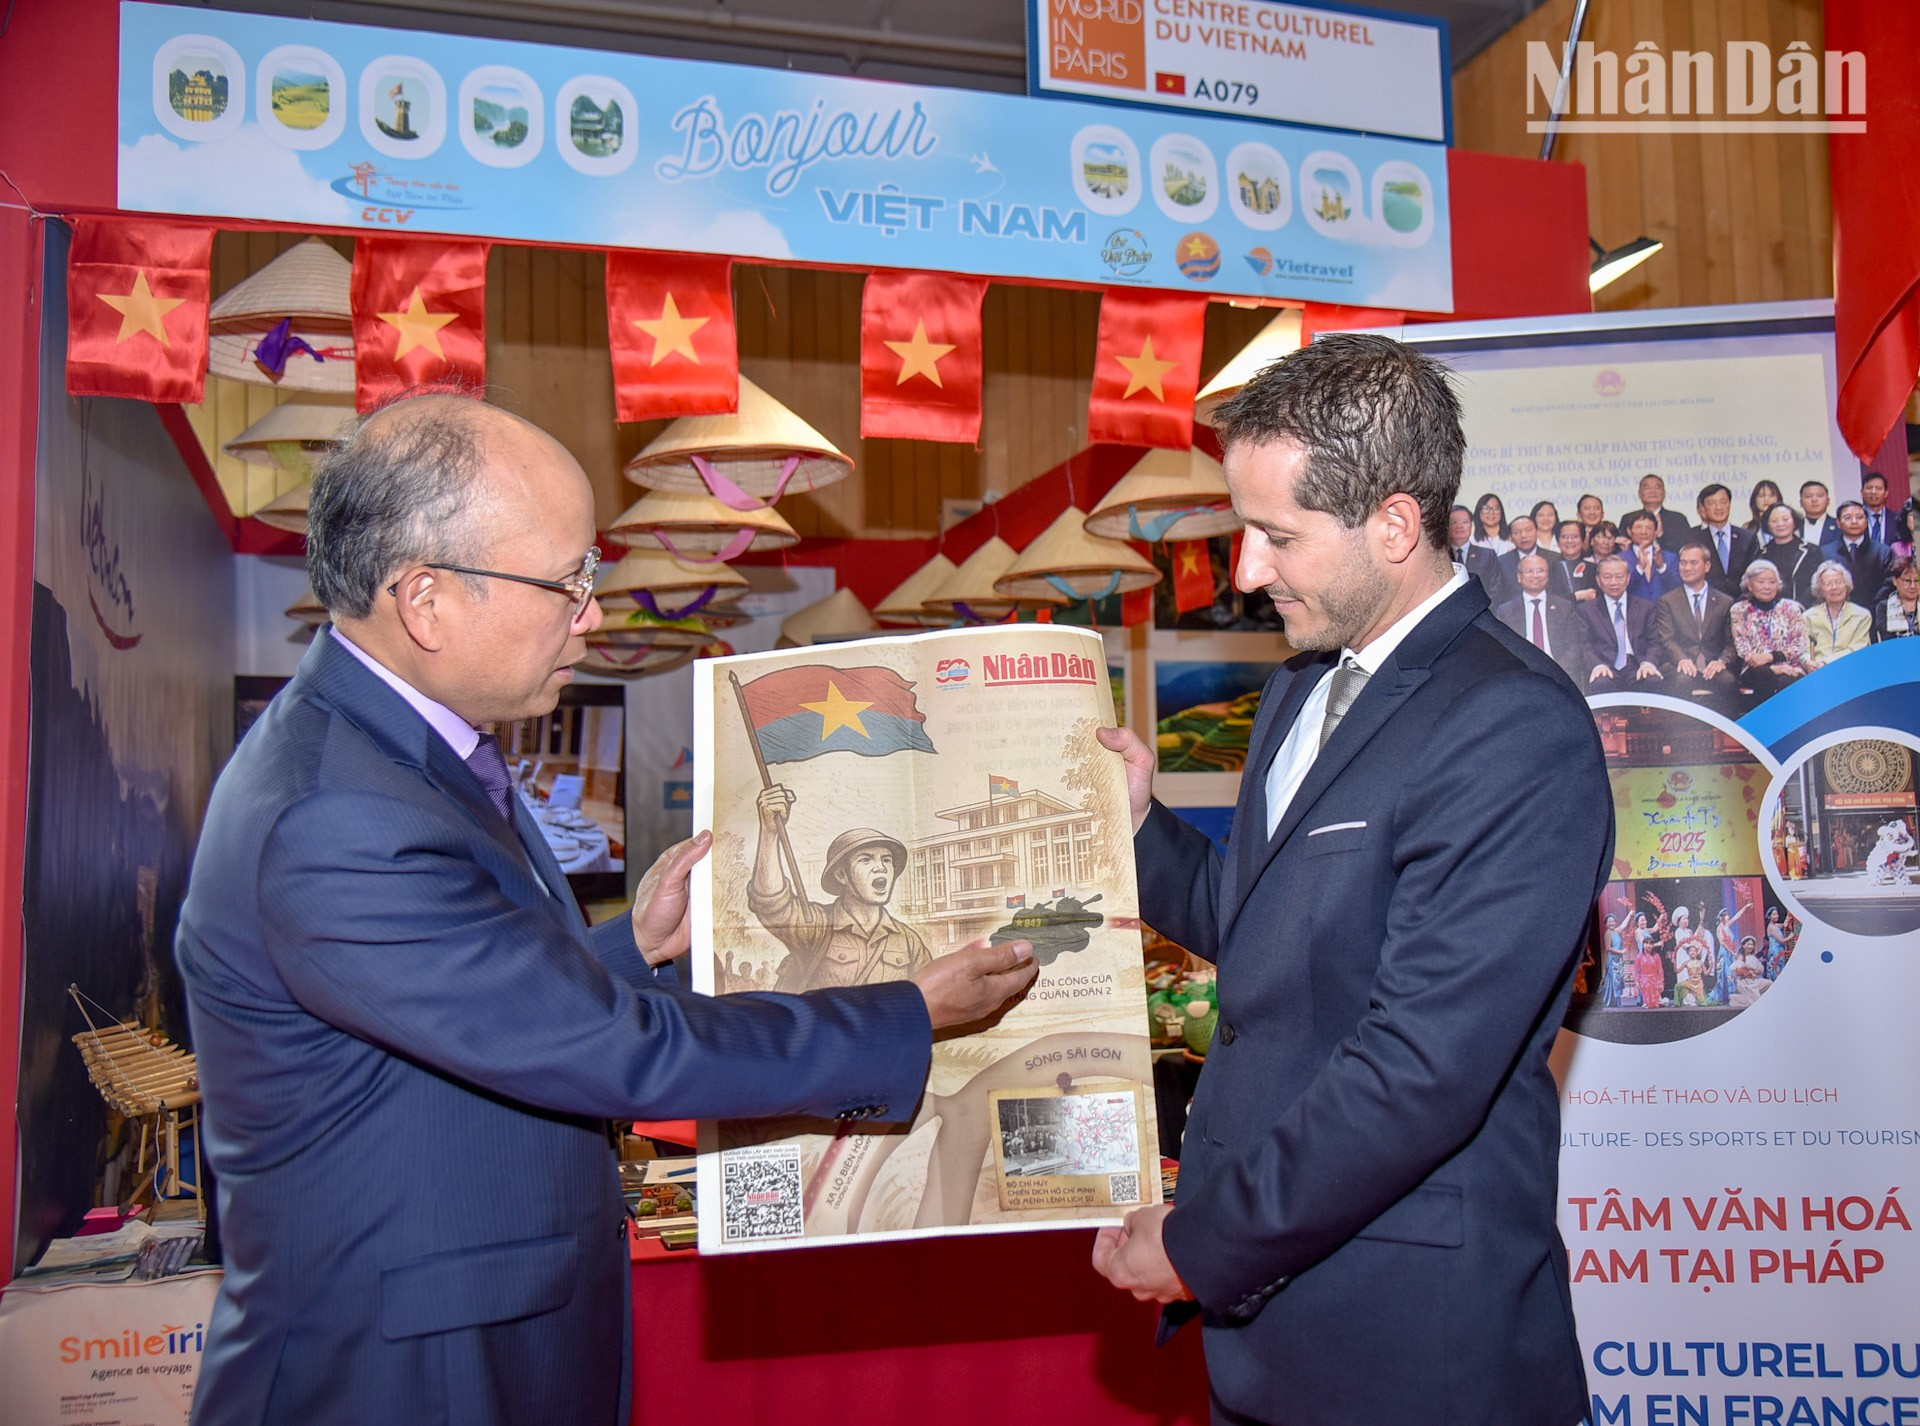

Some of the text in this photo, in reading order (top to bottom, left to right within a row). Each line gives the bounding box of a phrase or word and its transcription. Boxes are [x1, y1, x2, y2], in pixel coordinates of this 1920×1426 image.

[1052, 0, 1142, 24] WORLD
[1155, 0, 1375, 47] CENTRE CULTUREL
[1054, 17, 1083, 46] IN
[1156, 18, 1308, 61] DU VIETNAM
[1054, 44, 1128, 80] PARIS
[1194, 78, 1259, 105] A079
[656, 97, 938, 195] Bonjour
[362, 206, 415, 225] CCV
[817, 183, 1089, 243] VIỆT NAM
[1275, 258, 1353, 278] Vietravel
[1741, 452, 1770, 464] NAM
[983, 653, 1096, 680] Nhân Dân
[1660, 830, 1706, 853] 2025
[1024, 918, 1041, 928] 843
[1091, 972, 1113, 984] CỦA
[1106, 986, 1112, 995] 2
[1568, 1085, 1658, 1105] HOÁ-THỂ
[1662, 1088, 1719, 1104] THAO
[1724, 1086, 1752, 1103] VÀ
[1758, 1087, 1787, 1103] DU
[1794, 1087, 1839, 1107] LỊCH
[1645, 1131, 1684, 1147] DES
[1690, 1131, 1767, 1146] SPORTS
[1774, 1131, 1797, 1146] ET
[1803, 1130, 1832, 1146] DU
[1076, 1186, 1096, 1194] MINH
[1568, 1186, 1913, 1231] TÂM VĂN HOÁ
[1568, 1239, 1885, 1293] AM TẠI PHÁP
[90, 1363, 192, 1381] Agence de voyage
[1592, 1341, 1920, 1378] CULTUREL DU
[1646, 1394, 1709, 1426] EN
[1724, 1394, 1920, 1426] FRANCE
